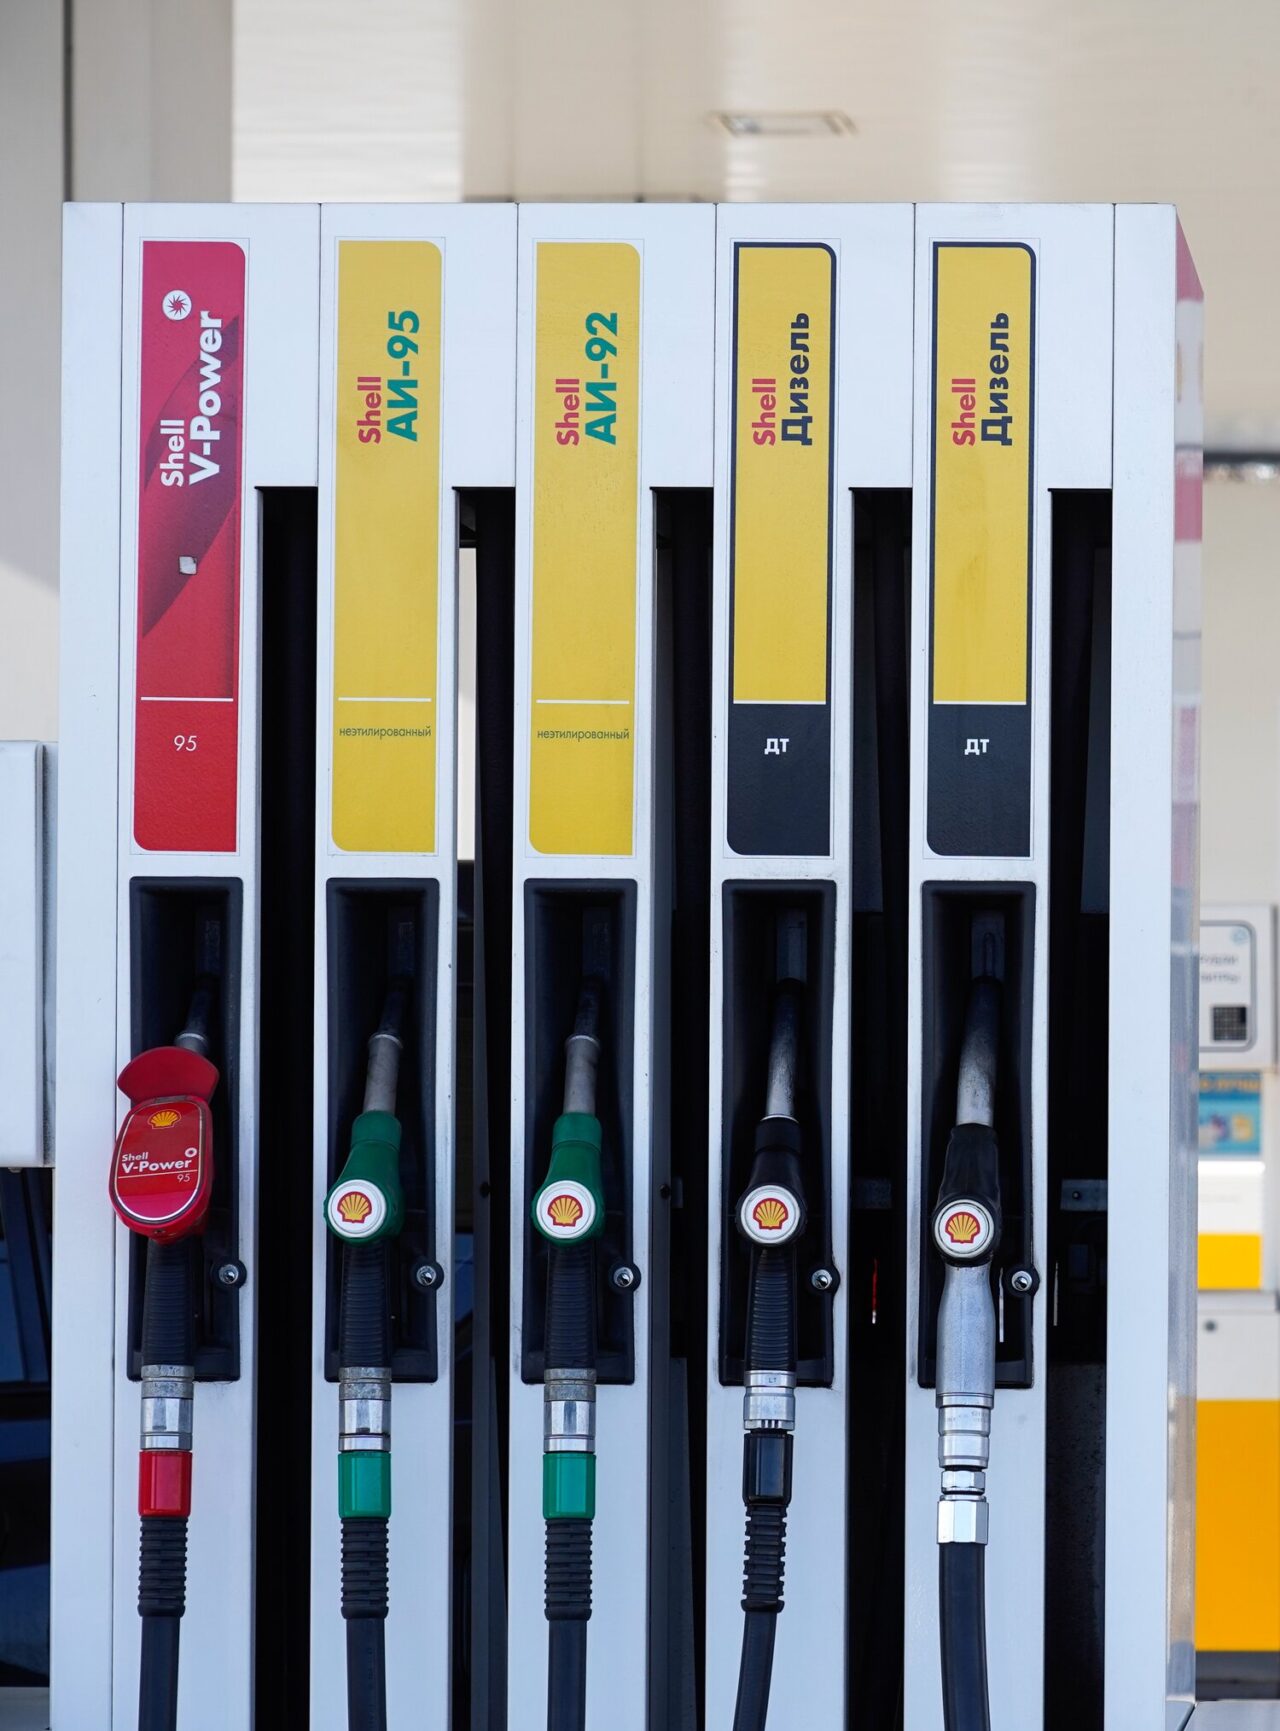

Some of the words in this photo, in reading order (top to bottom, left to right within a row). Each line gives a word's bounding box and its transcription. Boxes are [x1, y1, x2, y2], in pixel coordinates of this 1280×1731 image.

[189, 310, 223, 485] V-Power
[357, 376, 382, 444] Shell
[387, 310, 420, 442] АИ-95
[585, 312, 618, 445] АИ-92
[781, 312, 813, 446] Дизель
[981, 312, 1013, 446] Дизель
[555, 378, 580, 446] Shell
[752, 378, 776, 446] Shell
[952, 378, 976, 446] Shell
[160, 419, 184, 487] Shell
[173, 735, 198, 752] 95
[339, 725, 432, 740] неэтилированный
[537, 727, 630, 743] неэтилированный
[121, 1152, 149, 1162] Shell
[122, 1159, 192, 1173] V-Power
[177, 1173, 190, 1183] 95
